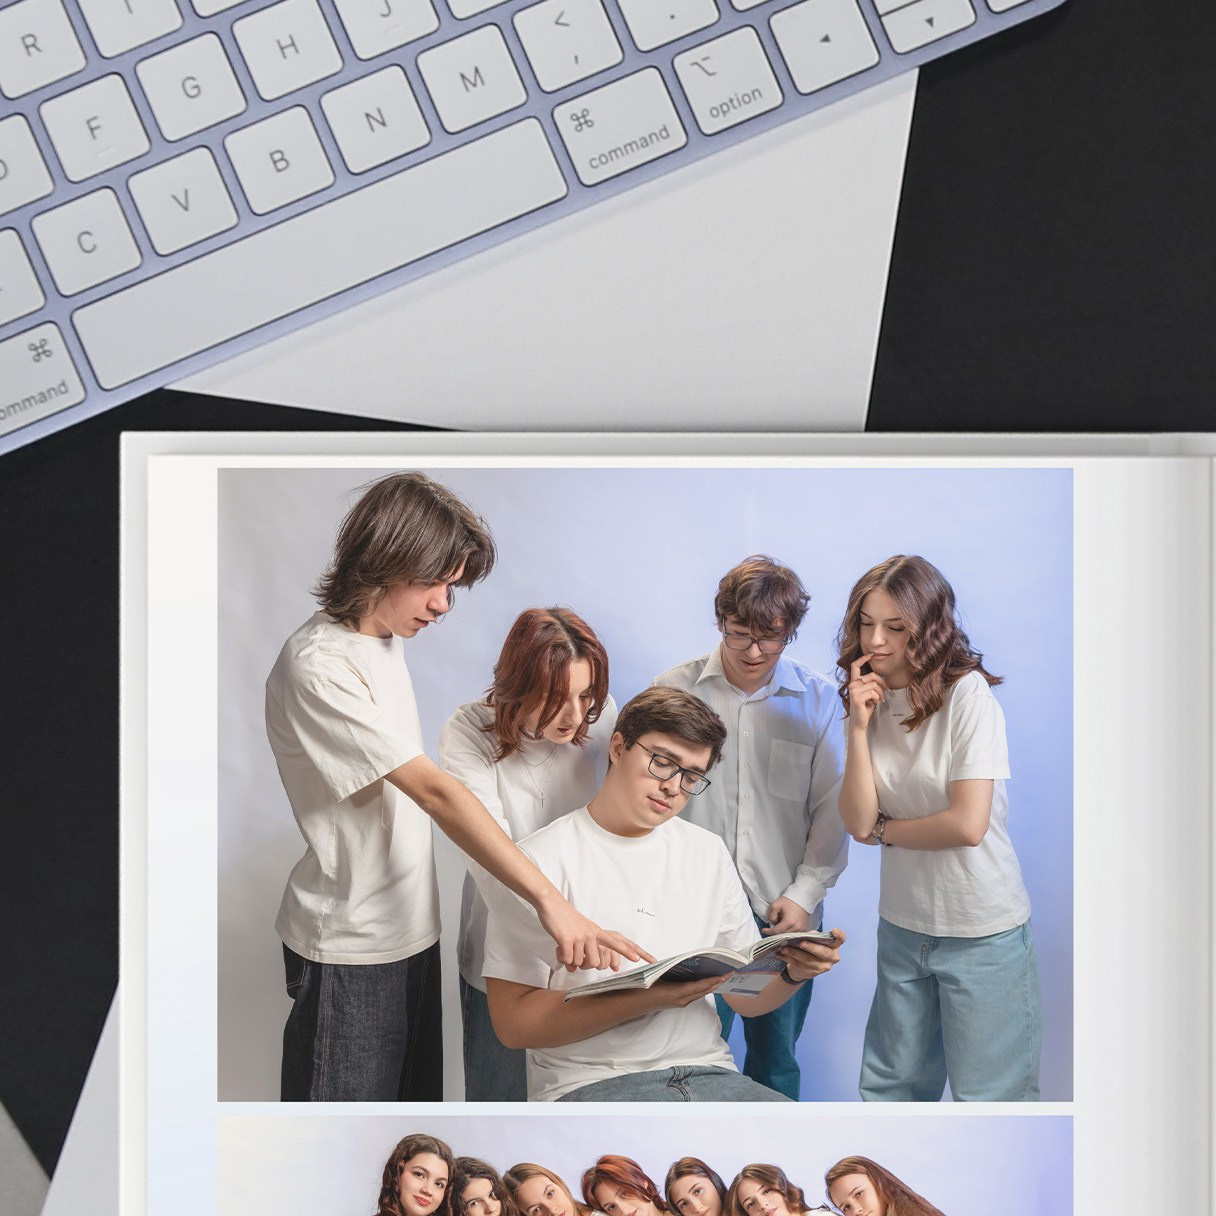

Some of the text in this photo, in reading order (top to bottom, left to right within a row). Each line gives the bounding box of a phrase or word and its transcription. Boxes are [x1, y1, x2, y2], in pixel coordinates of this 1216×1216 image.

[21, 33, 42, 57] R
[276, 34, 300, 60] H
[180, 75, 202, 99] G
[459, 66, 486, 92] M
[708, 85, 763, 120] option
[85, 115, 103, 140] F
[364, 107, 388, 133] N
[588, 125, 671, 170] command
[269, 149, 290, 173] B
[171, 188, 190, 212] V
[77, 230, 98, 254] C
[0, 379, 70, 420] ommand
